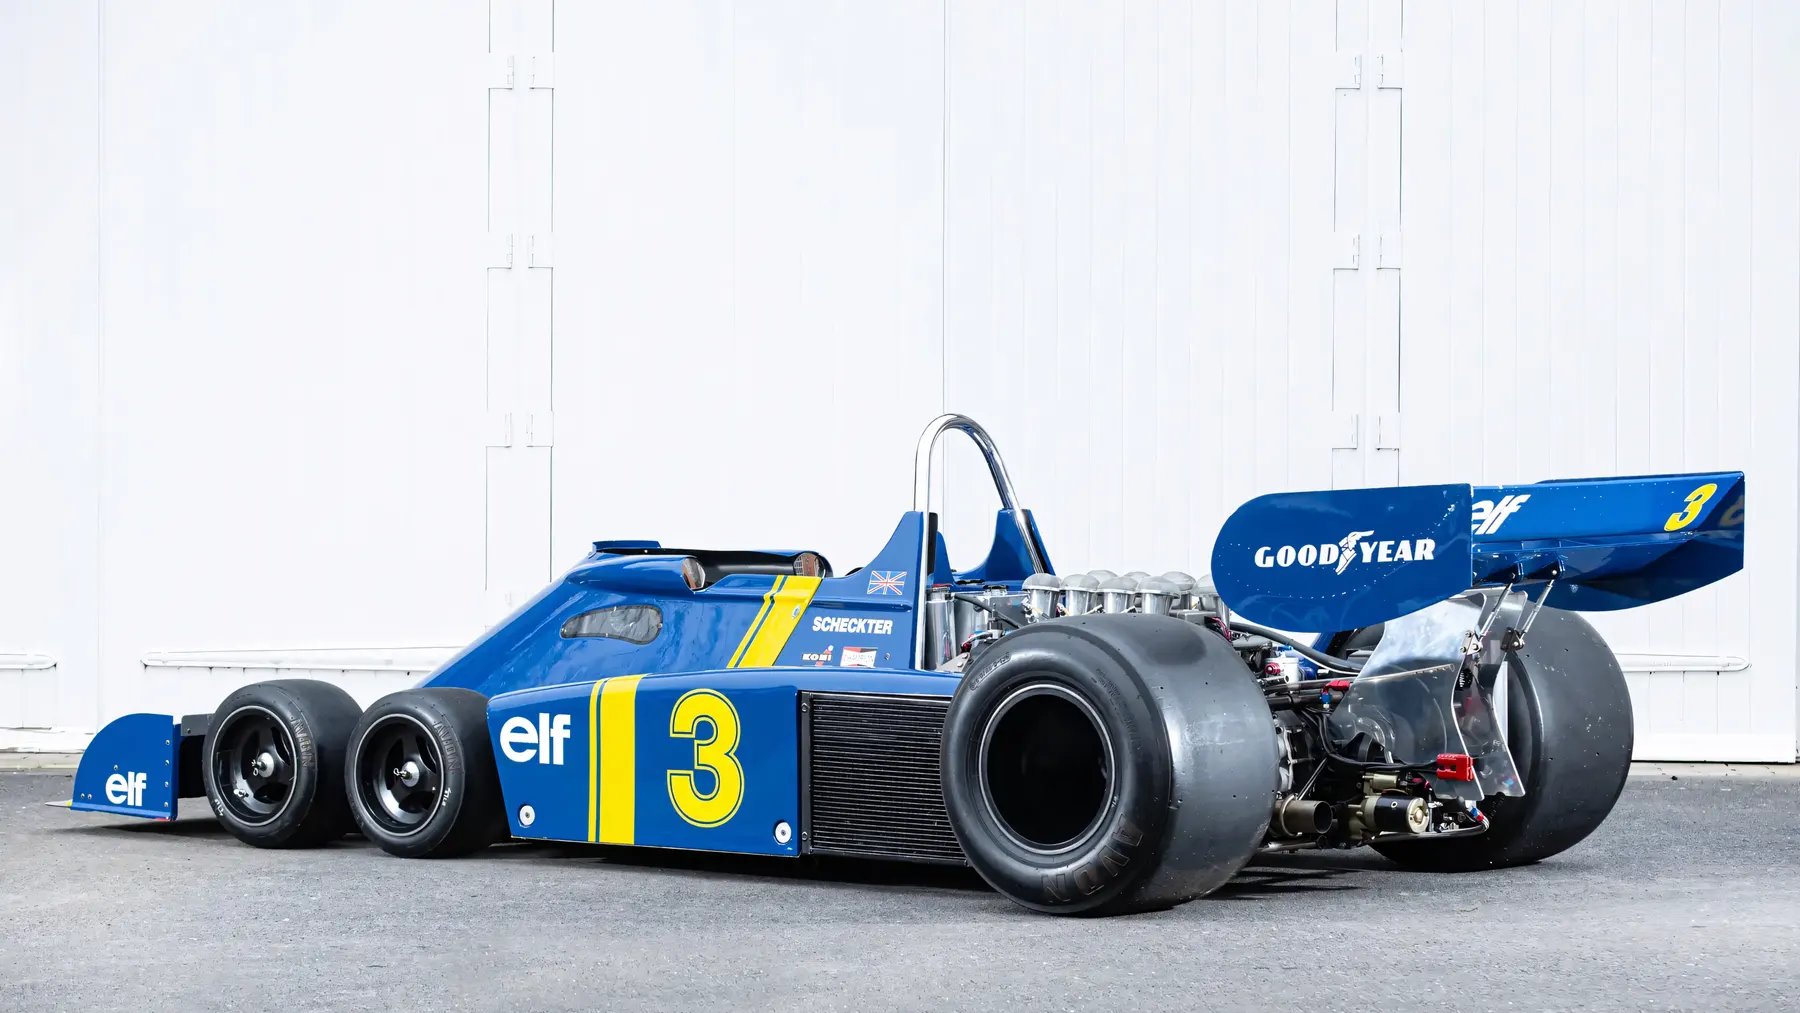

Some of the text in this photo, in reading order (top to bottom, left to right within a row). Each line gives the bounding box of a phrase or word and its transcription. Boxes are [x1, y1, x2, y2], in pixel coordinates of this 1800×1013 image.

[1664, 483, 1718, 532] 3
[812, 616, 893, 635] SCHECKTER
[802, 653, 832, 662] KONI
[499, 712, 571, 765] elf
[667, 689, 745, 828] 3
[105, 771, 147, 807] elf
